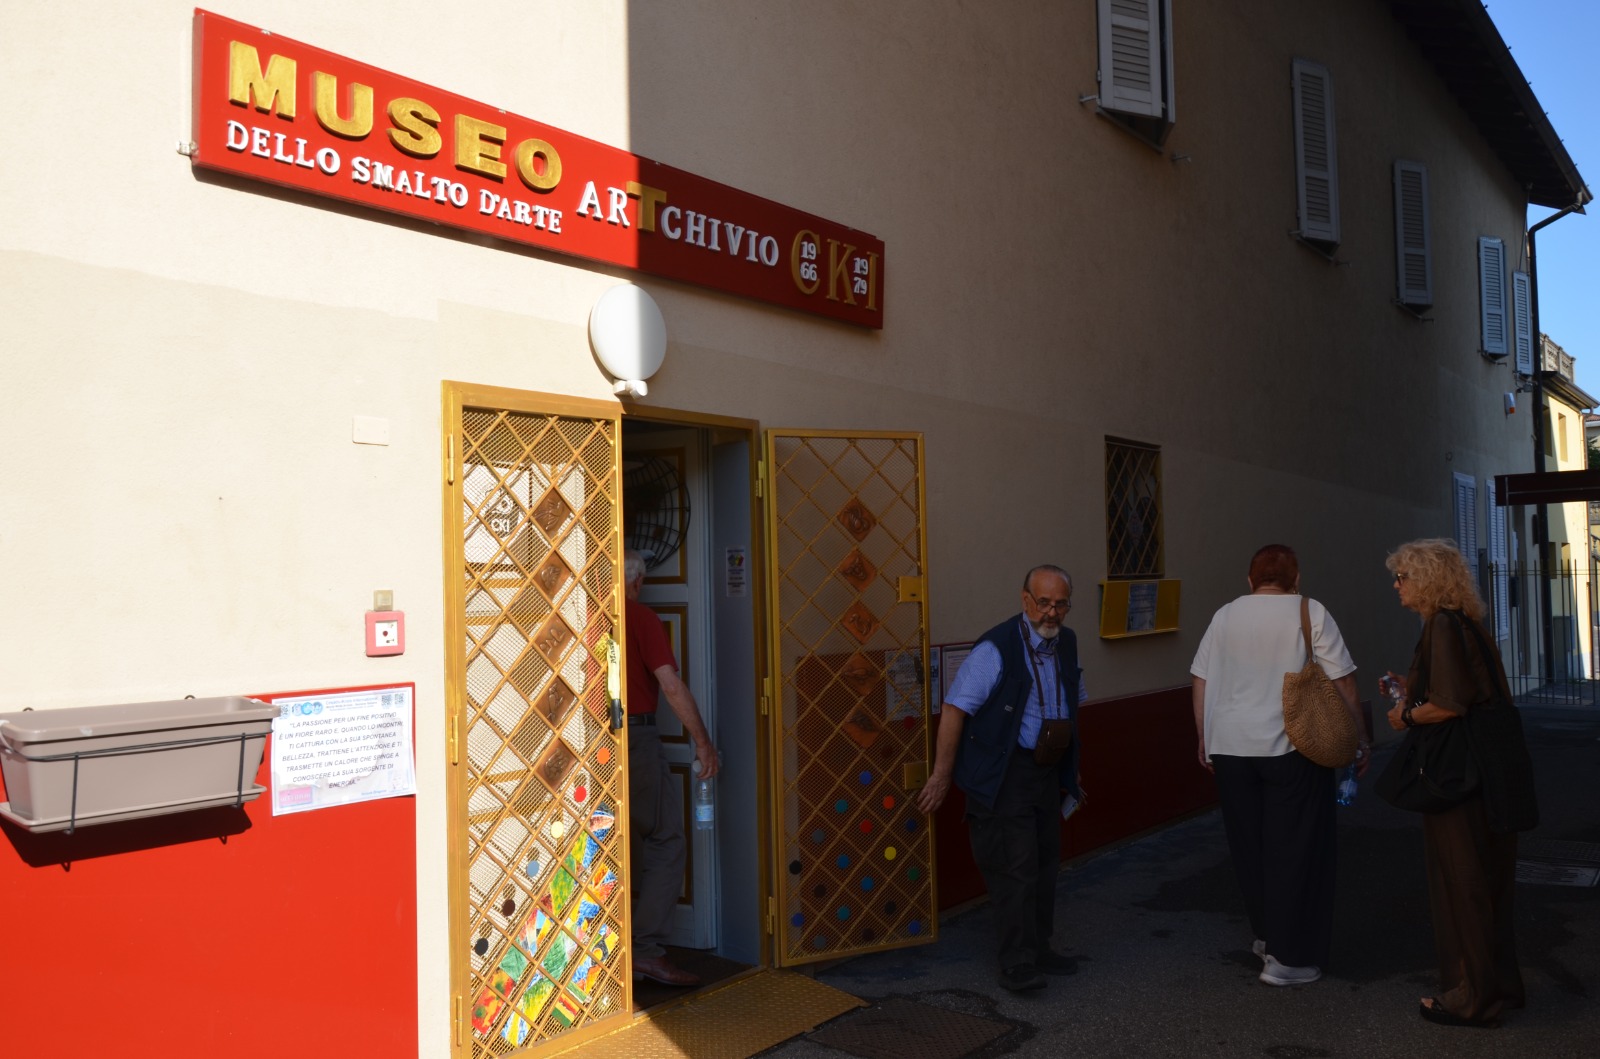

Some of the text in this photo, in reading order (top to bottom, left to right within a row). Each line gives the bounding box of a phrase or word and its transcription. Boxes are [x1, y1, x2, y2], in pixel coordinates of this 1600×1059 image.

[228, 40, 563, 192] MUSEO
[225, 120, 563, 234] DELLO SMALTO D'ARTE
[800, 240, 817, 260] 19
[800, 261, 818, 282] 66
[853, 257, 869, 276] 19
[853, 276, 868, 295] 79
[302, 718, 332, 727] PASSIONE
[347, 715, 356, 723] UN
[371, 711, 397, 720] POSITIVO
[295, 730, 314, 739] FIORE
[315, 728, 333, 736] RARO
[341, 724, 367, 733] QUANDO
[295, 740, 324, 749] CATTURA
[325, 738, 339, 746] CON
[340, 736, 348, 744] LA
[349, 735, 361, 743] SUA
[362, 731, 397, 741] SPONTANEA
[317, 747, 350, 758] TRATTIENE
[286, 761, 323, 772] TRASMETTE
[334, 757, 359, 766] CALORE
[359, 755, 372, 763] CHE
[292, 771, 332, 783] CONOSCERE
[355, 764, 387, 774] SORGENTE
